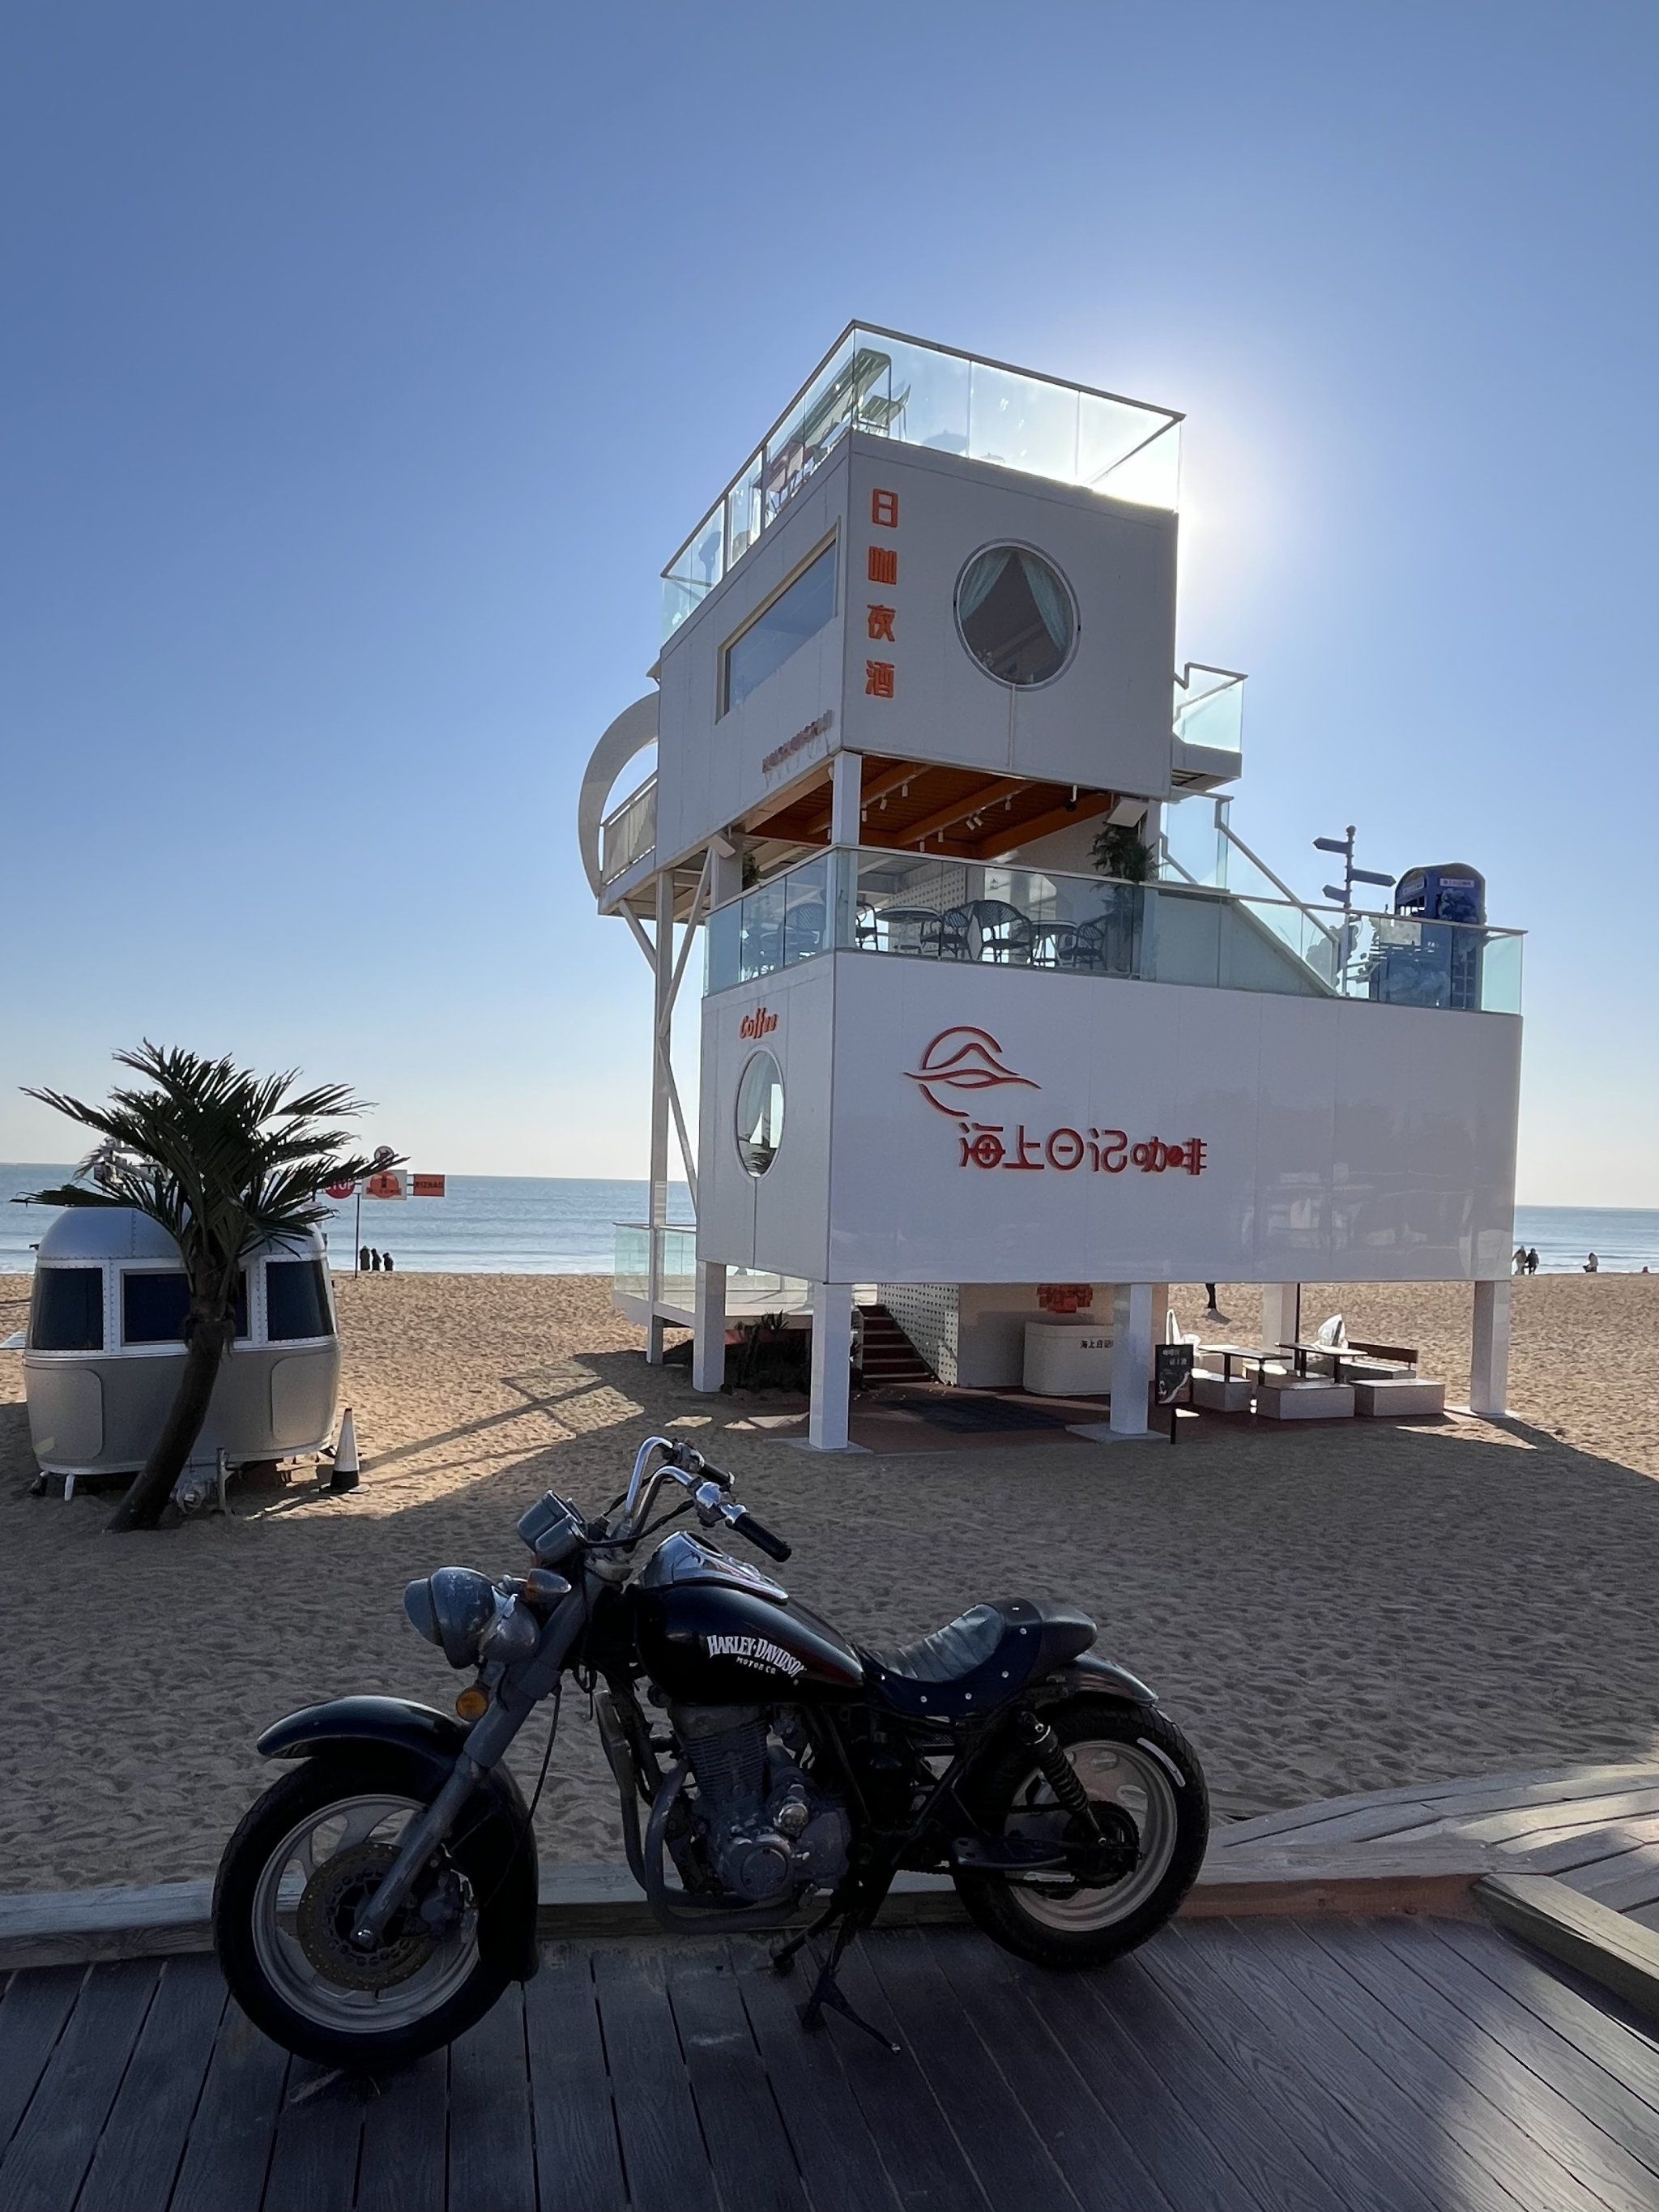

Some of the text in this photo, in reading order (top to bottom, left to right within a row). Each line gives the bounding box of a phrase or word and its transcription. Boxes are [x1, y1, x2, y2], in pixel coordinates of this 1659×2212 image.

[959, 1122, 1207, 1175] 海上日记咖啡
[736, 1656, 765, 1671] MOTOR
